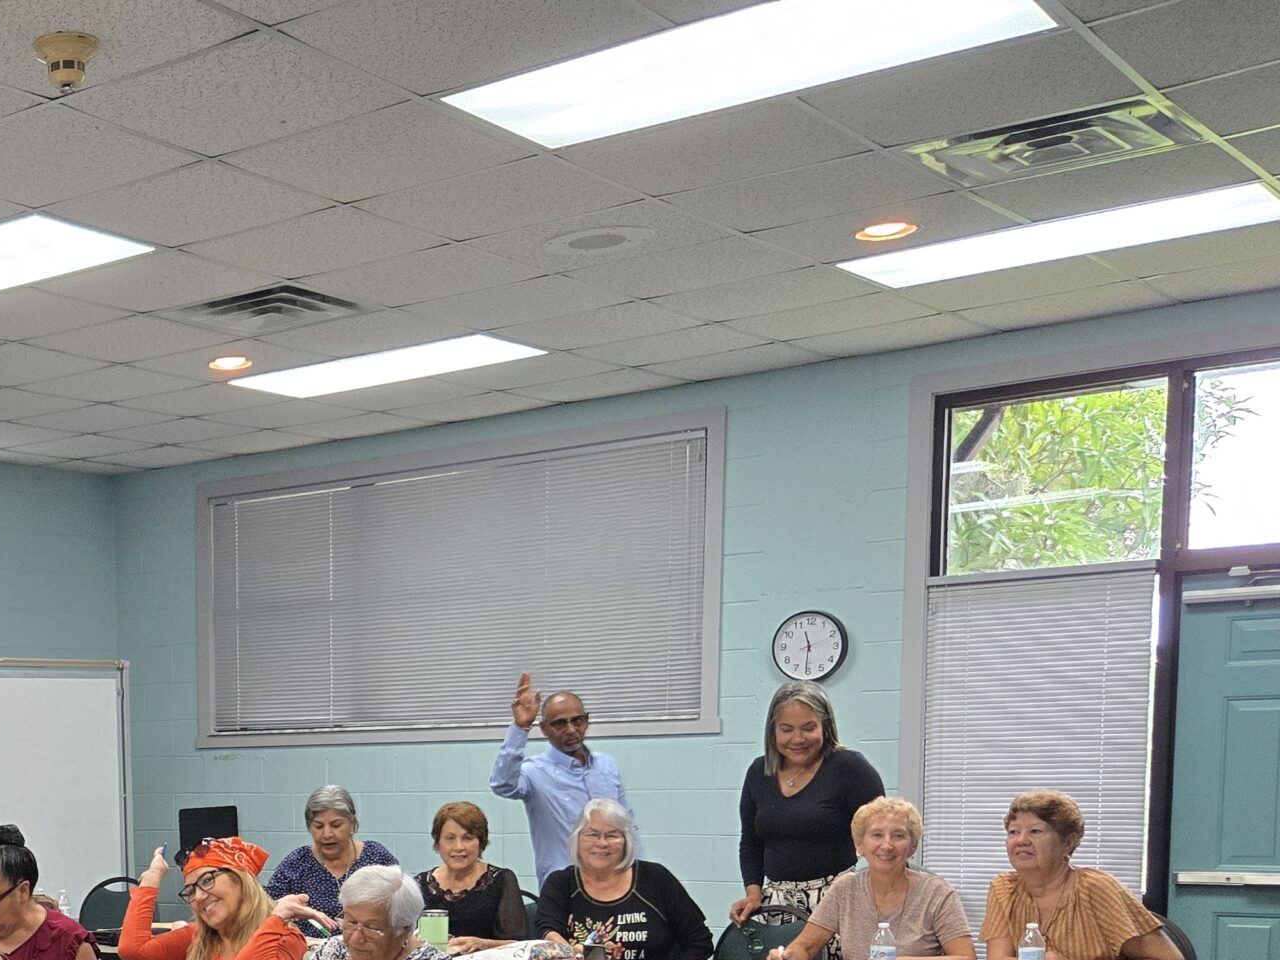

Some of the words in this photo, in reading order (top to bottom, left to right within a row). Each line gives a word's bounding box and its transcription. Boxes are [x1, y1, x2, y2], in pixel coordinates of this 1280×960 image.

[794, 621, 803, 629] 11
[806, 617, 816, 625] 12
[829, 630, 836, 638] 2
[780, 643, 786, 651] 9
[833, 642, 839, 650] 3
[784, 656, 790, 664] 8
[827, 655, 834, 663] 4
[805, 667, 811, 675] 6
[617, 911, 648, 925] LIVING
[615, 930, 649, 942] PROOF
[624, 949, 637, 960] OF
[638, 949, 646, 960] A
